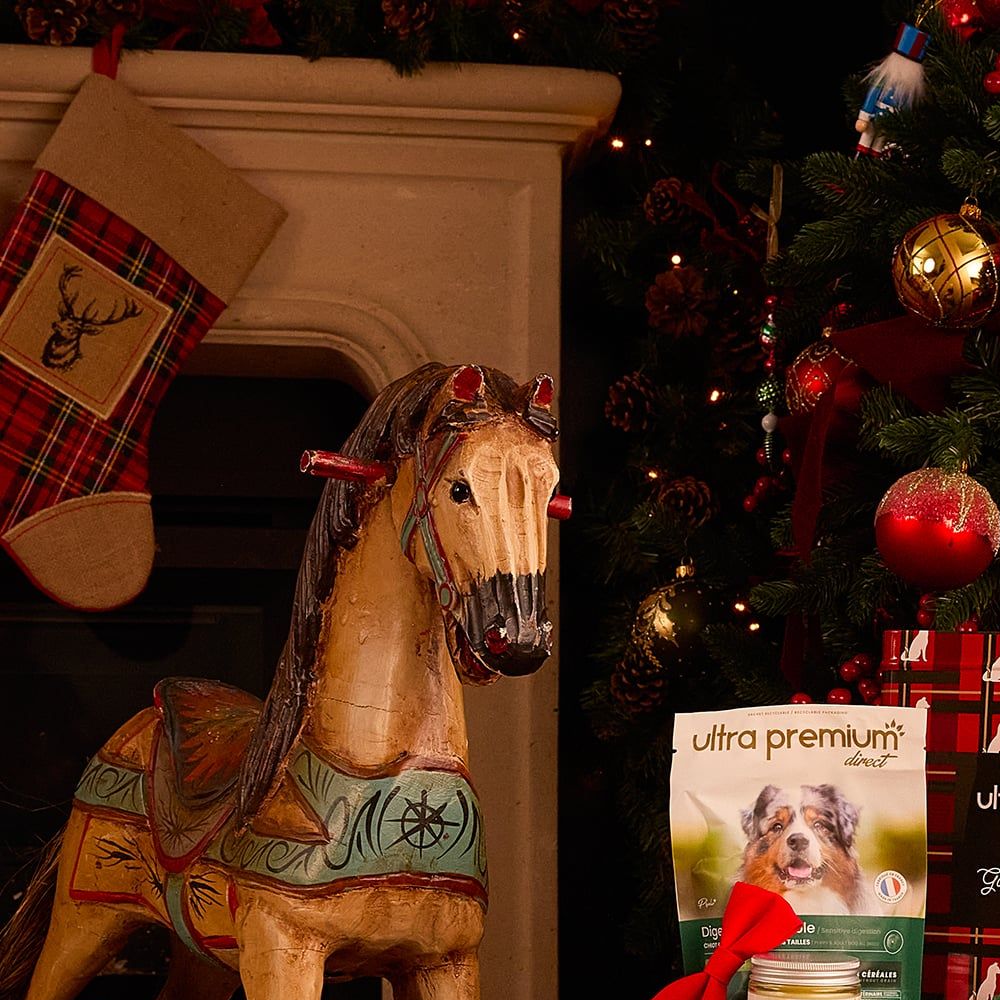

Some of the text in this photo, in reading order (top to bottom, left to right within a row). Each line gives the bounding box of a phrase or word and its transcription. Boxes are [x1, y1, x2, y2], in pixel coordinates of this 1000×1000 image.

[692, 724, 899, 761] ultra premium
[844, 750, 898, 768] direct
[861, 970, 897, 978] CÉRÉALES
